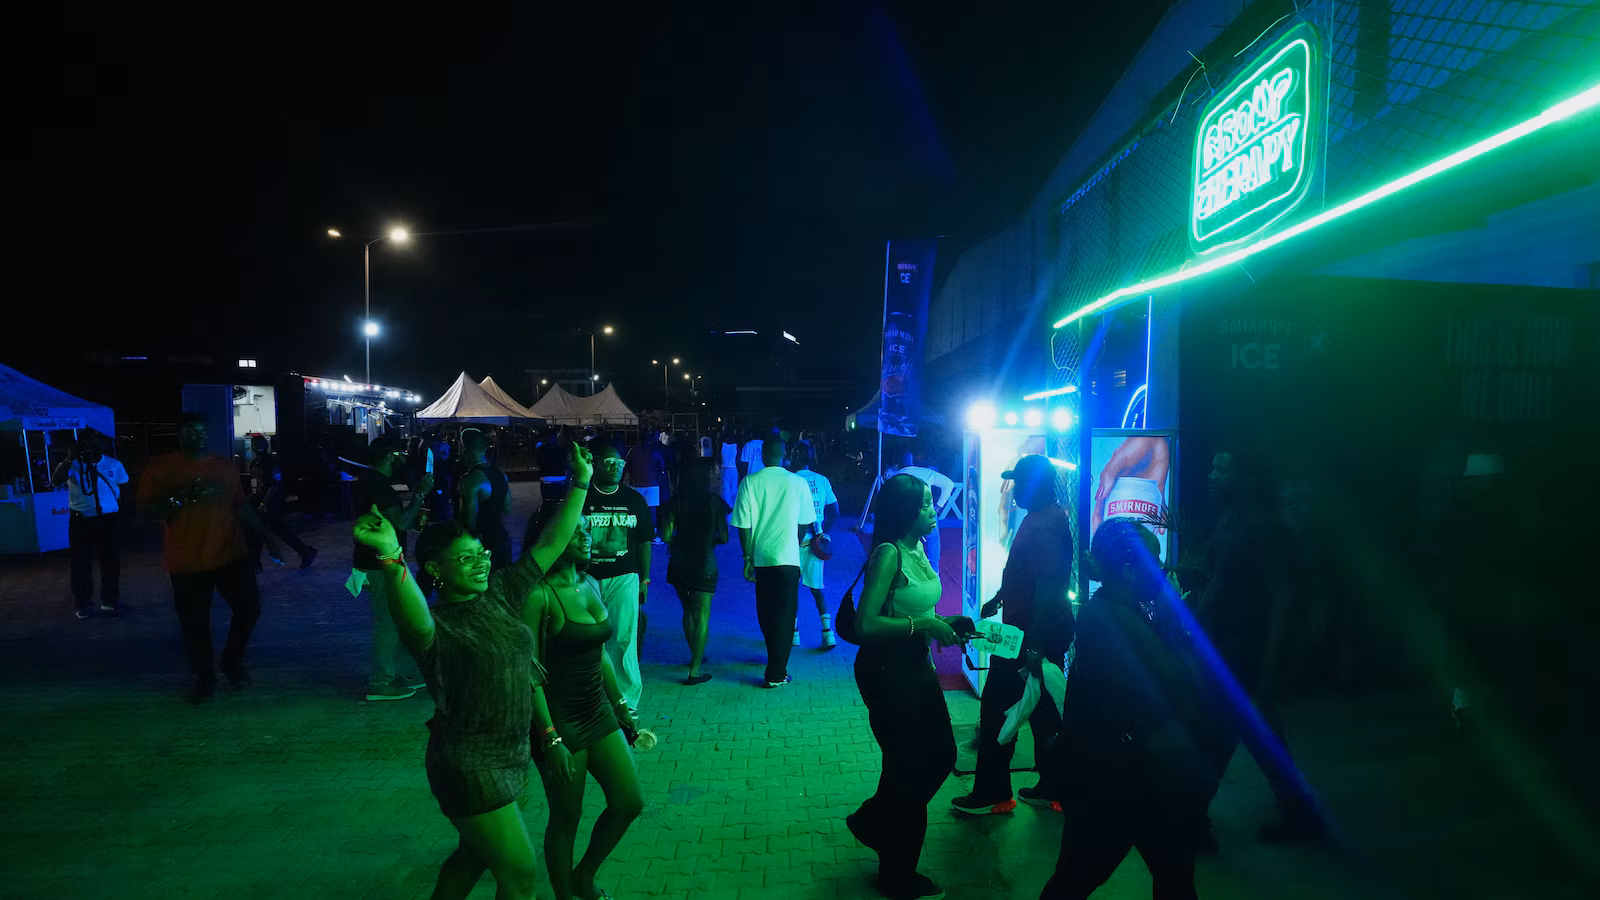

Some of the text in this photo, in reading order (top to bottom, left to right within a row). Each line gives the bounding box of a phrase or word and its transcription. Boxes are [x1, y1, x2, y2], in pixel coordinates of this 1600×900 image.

[1202, 66, 1293, 169] GROUP
[1198, 117, 1300, 220] THERAPY
[1219, 318, 1294, 337] SMIRNOFF
[888, 343, 906, 354] ICE
[1230, 342, 1281, 370] ICE
[1110, 501, 1156, 514] SMIRNOFF
